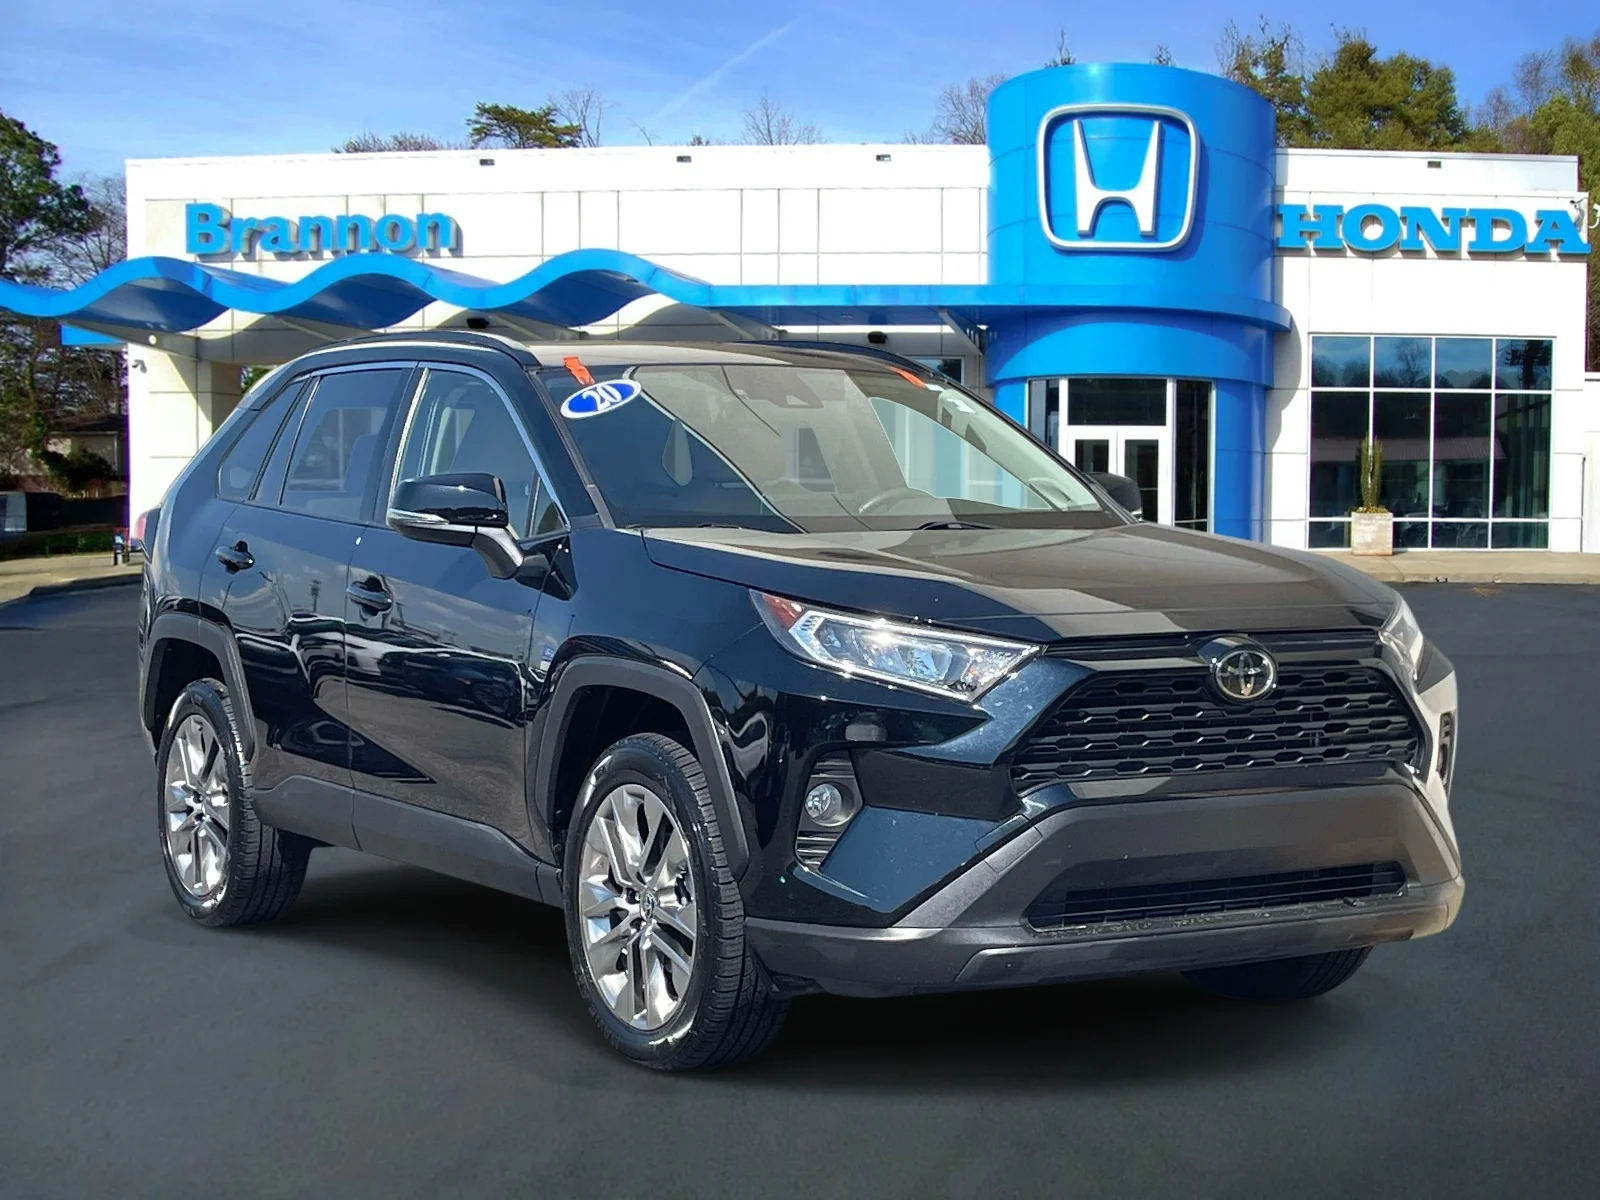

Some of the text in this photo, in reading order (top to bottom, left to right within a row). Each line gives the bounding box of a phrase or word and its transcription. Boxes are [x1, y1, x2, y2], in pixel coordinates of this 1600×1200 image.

[185, 202, 459, 256] Brannon
[1277, 203, 1591, 255] HONDA
[582, 384, 622, 411] 20
